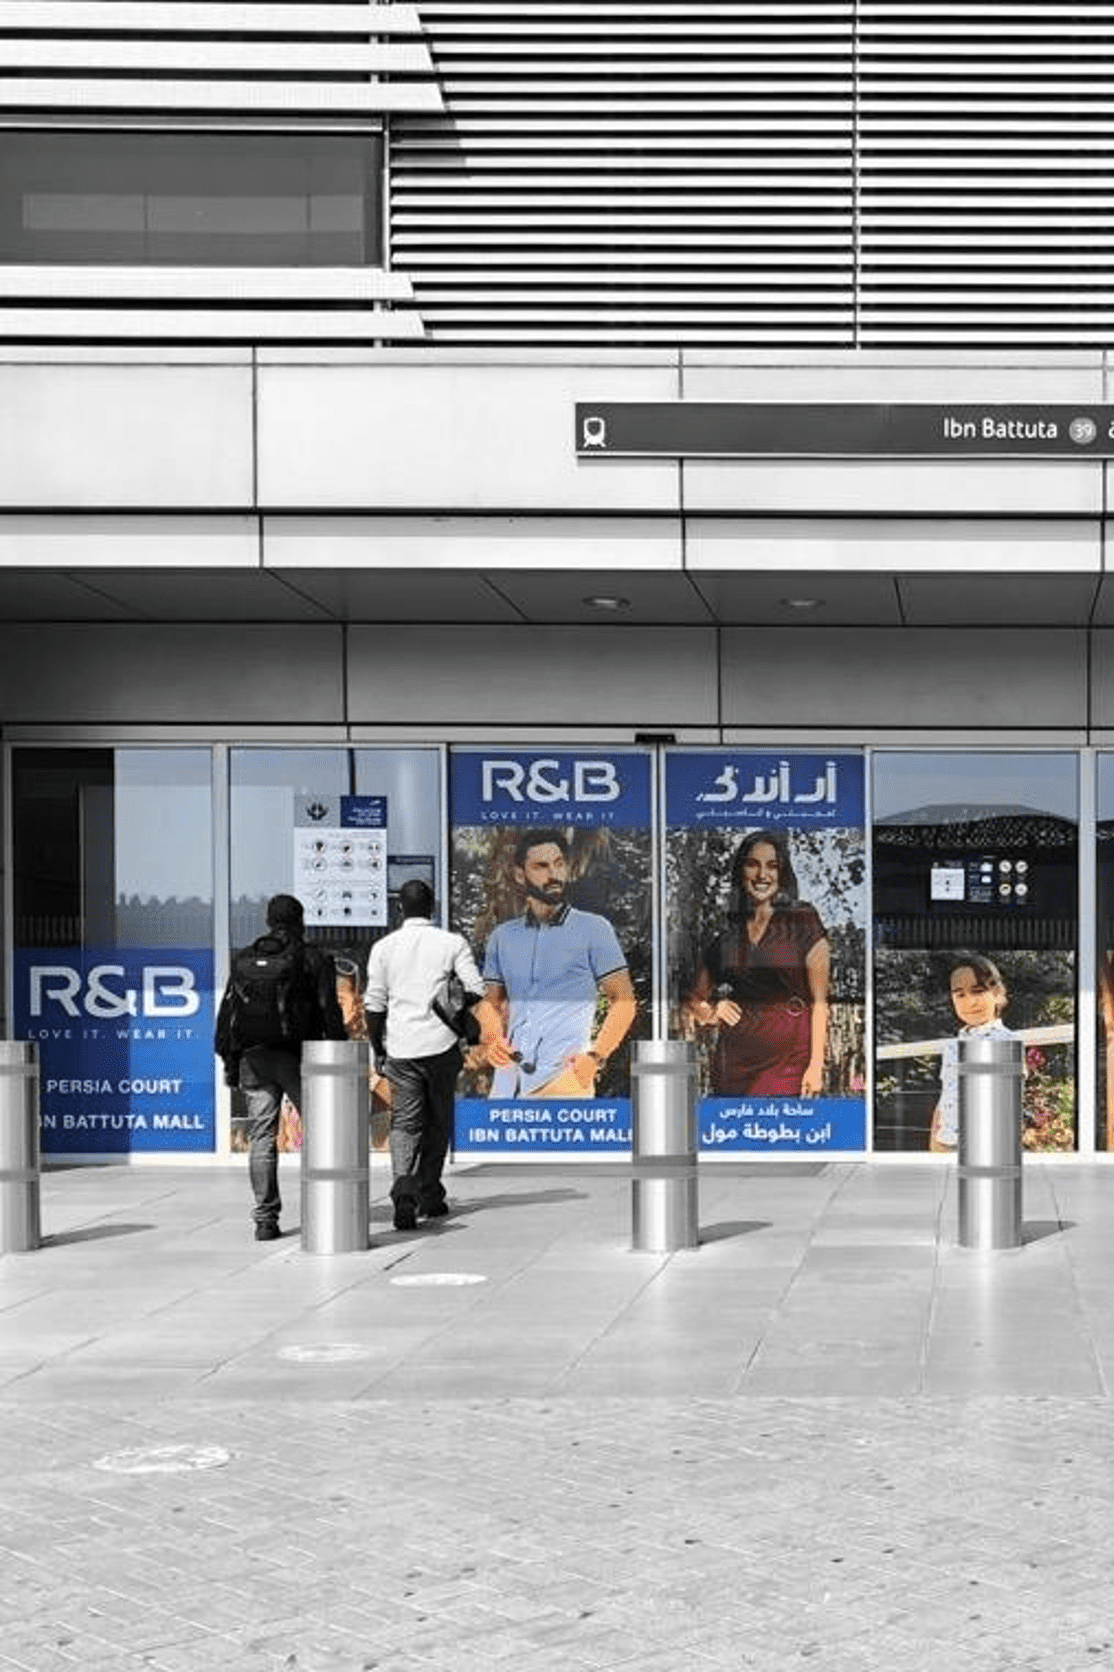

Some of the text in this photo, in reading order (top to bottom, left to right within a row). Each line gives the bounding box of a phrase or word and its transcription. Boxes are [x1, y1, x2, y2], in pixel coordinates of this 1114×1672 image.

[943, 417, 976, 438] Ibn
[982, 417, 1057, 438] Battuta
[482, 759, 620, 803] R&B
[29, 965, 200, 1018] R&B
[28, 1029, 72, 1039] LOVE
[116, 1029, 166, 1039] WEAR
[46, 1079, 183, 1094] PERSIA COURT
[63, 1114, 147, 1129] BATTUTA
[152, 1114, 205, 1129] MALL
[489, 1108, 617, 1123] PERSIA COURT
[469, 1128, 499, 1142] IBN
[505, 1128, 584, 1142] BATTUTA
[702, 1122, 738, 1144] مول
[742, 1122, 800, 1144] بطوطة
